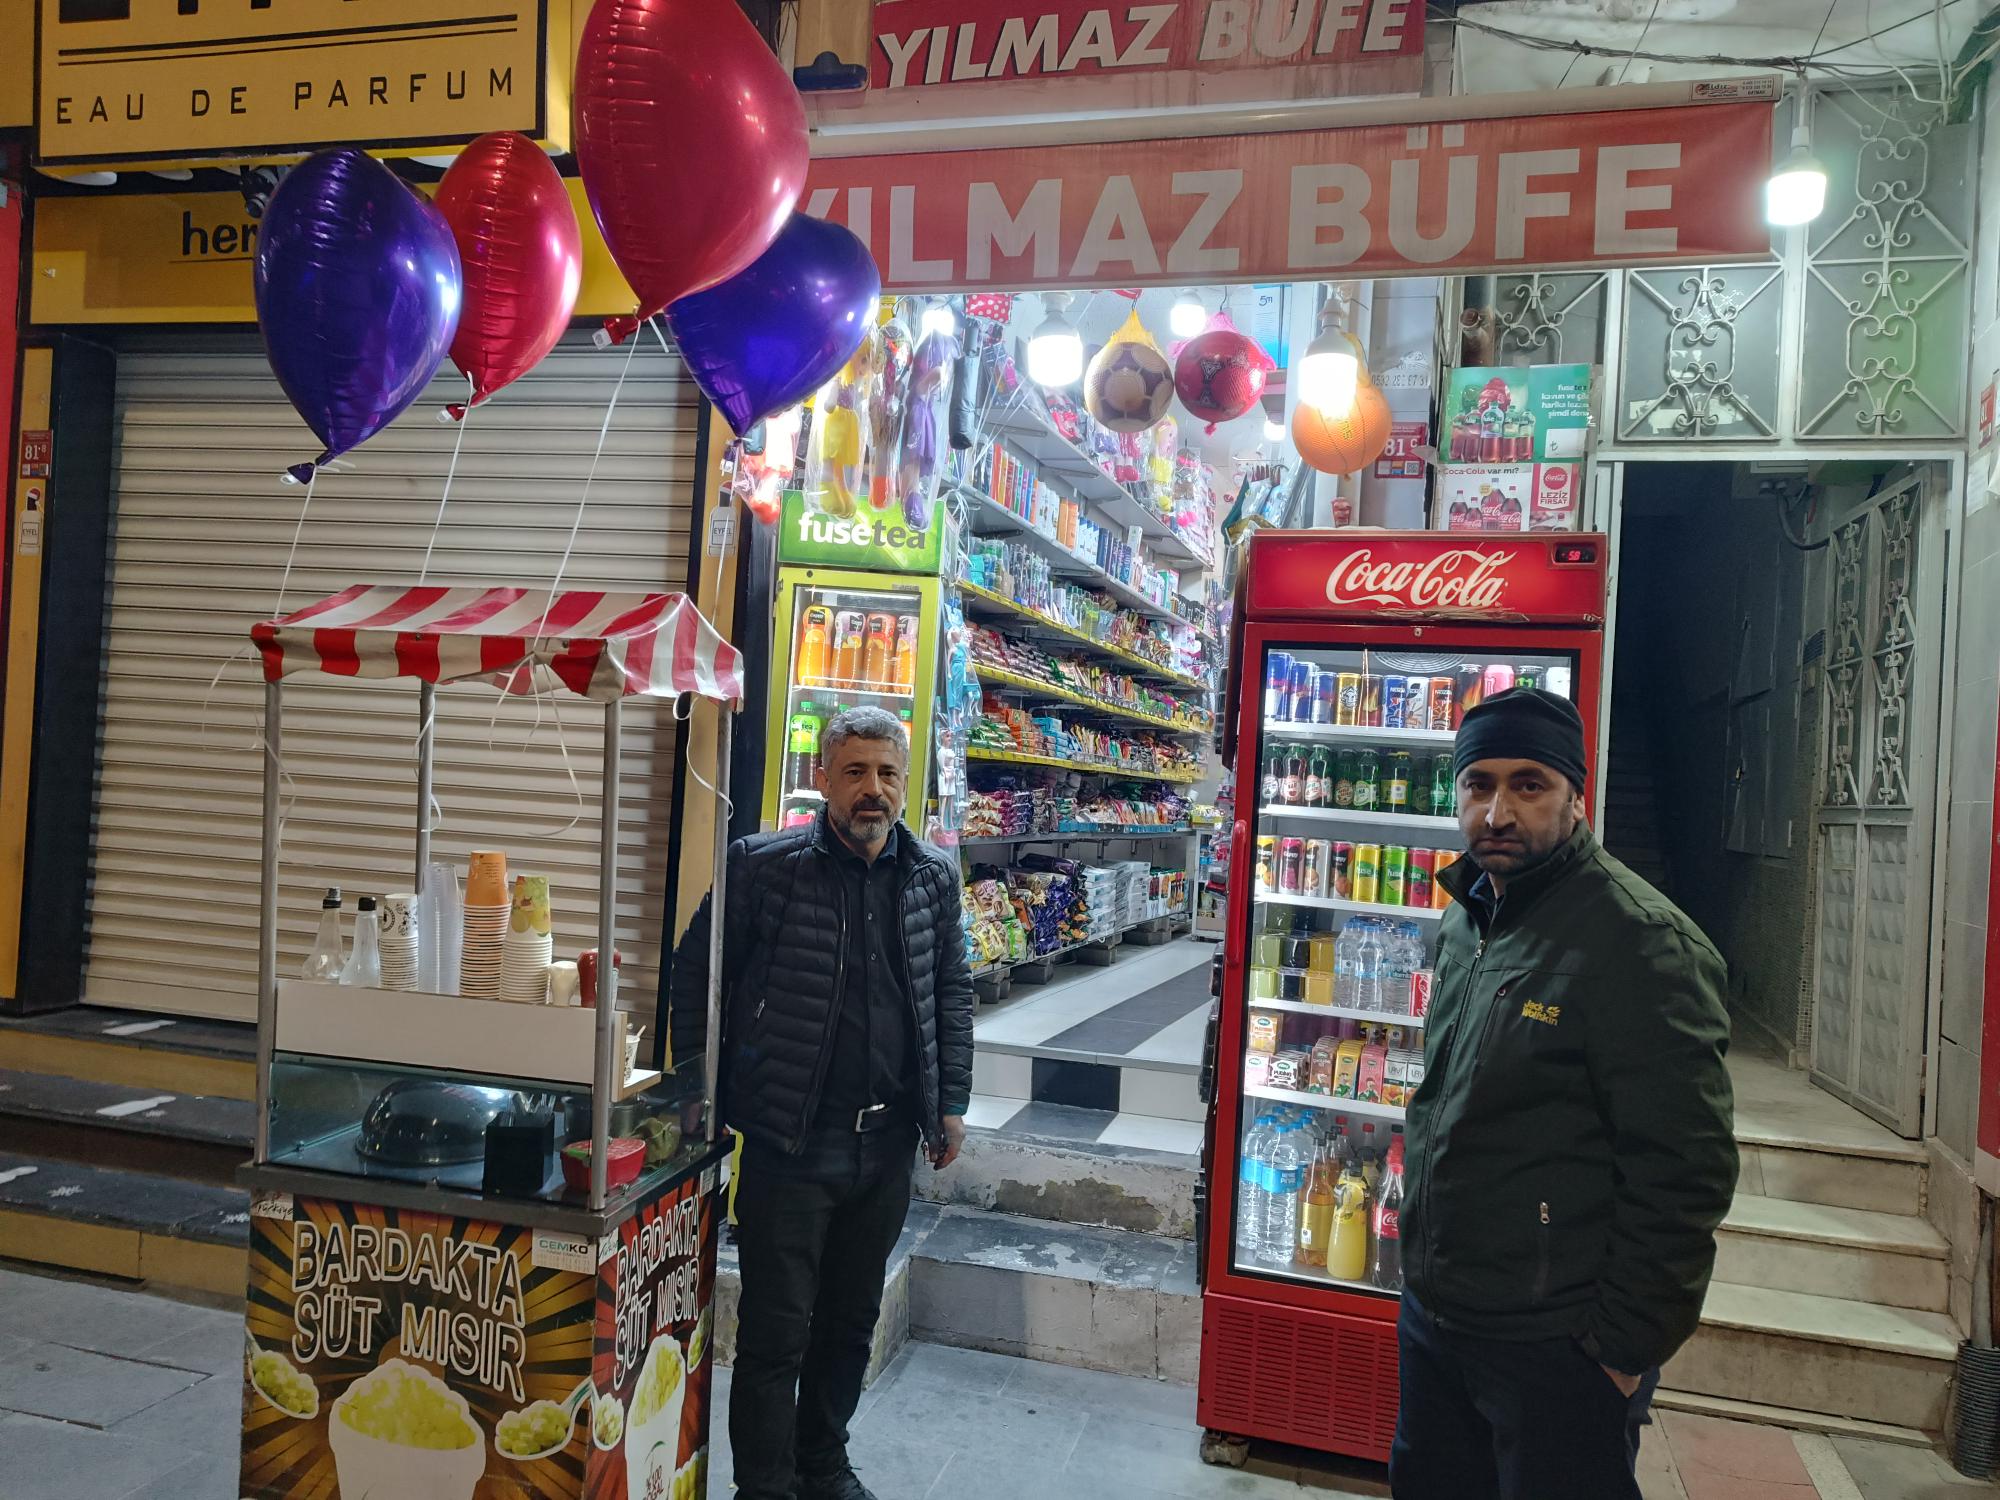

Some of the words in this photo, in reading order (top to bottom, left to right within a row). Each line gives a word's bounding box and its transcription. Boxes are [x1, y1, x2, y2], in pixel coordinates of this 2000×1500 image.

[880, 4, 1179, 88] YILMAZ
[56, 95, 144, 125] EAU
[191, 86, 248, 117] DE
[295, 67, 513, 110] PARFUM
[1287, 125, 1682, 268] BÜFE
[182, 211, 257, 256] her
[24, 444, 39, 460] 81
[1384, 438, 1406, 457] 81
[1540, 490, 1568, 499] LEZİZ
[798, 511, 926, 549] fusetea
[1325, 548, 1517, 607] Coca-Cola
[292, 1220, 526, 1328] BARDAKTA
[540, 1239, 588, 1254] CEMKO
[615, 1192, 700, 1325] BARDAKTA
[292, 1285, 382, 1363] SÜT
[401, 1302, 526, 1402] MISIR
[613, 1290, 652, 1391] SÜT
[656, 1257, 700, 1333] MISIR
